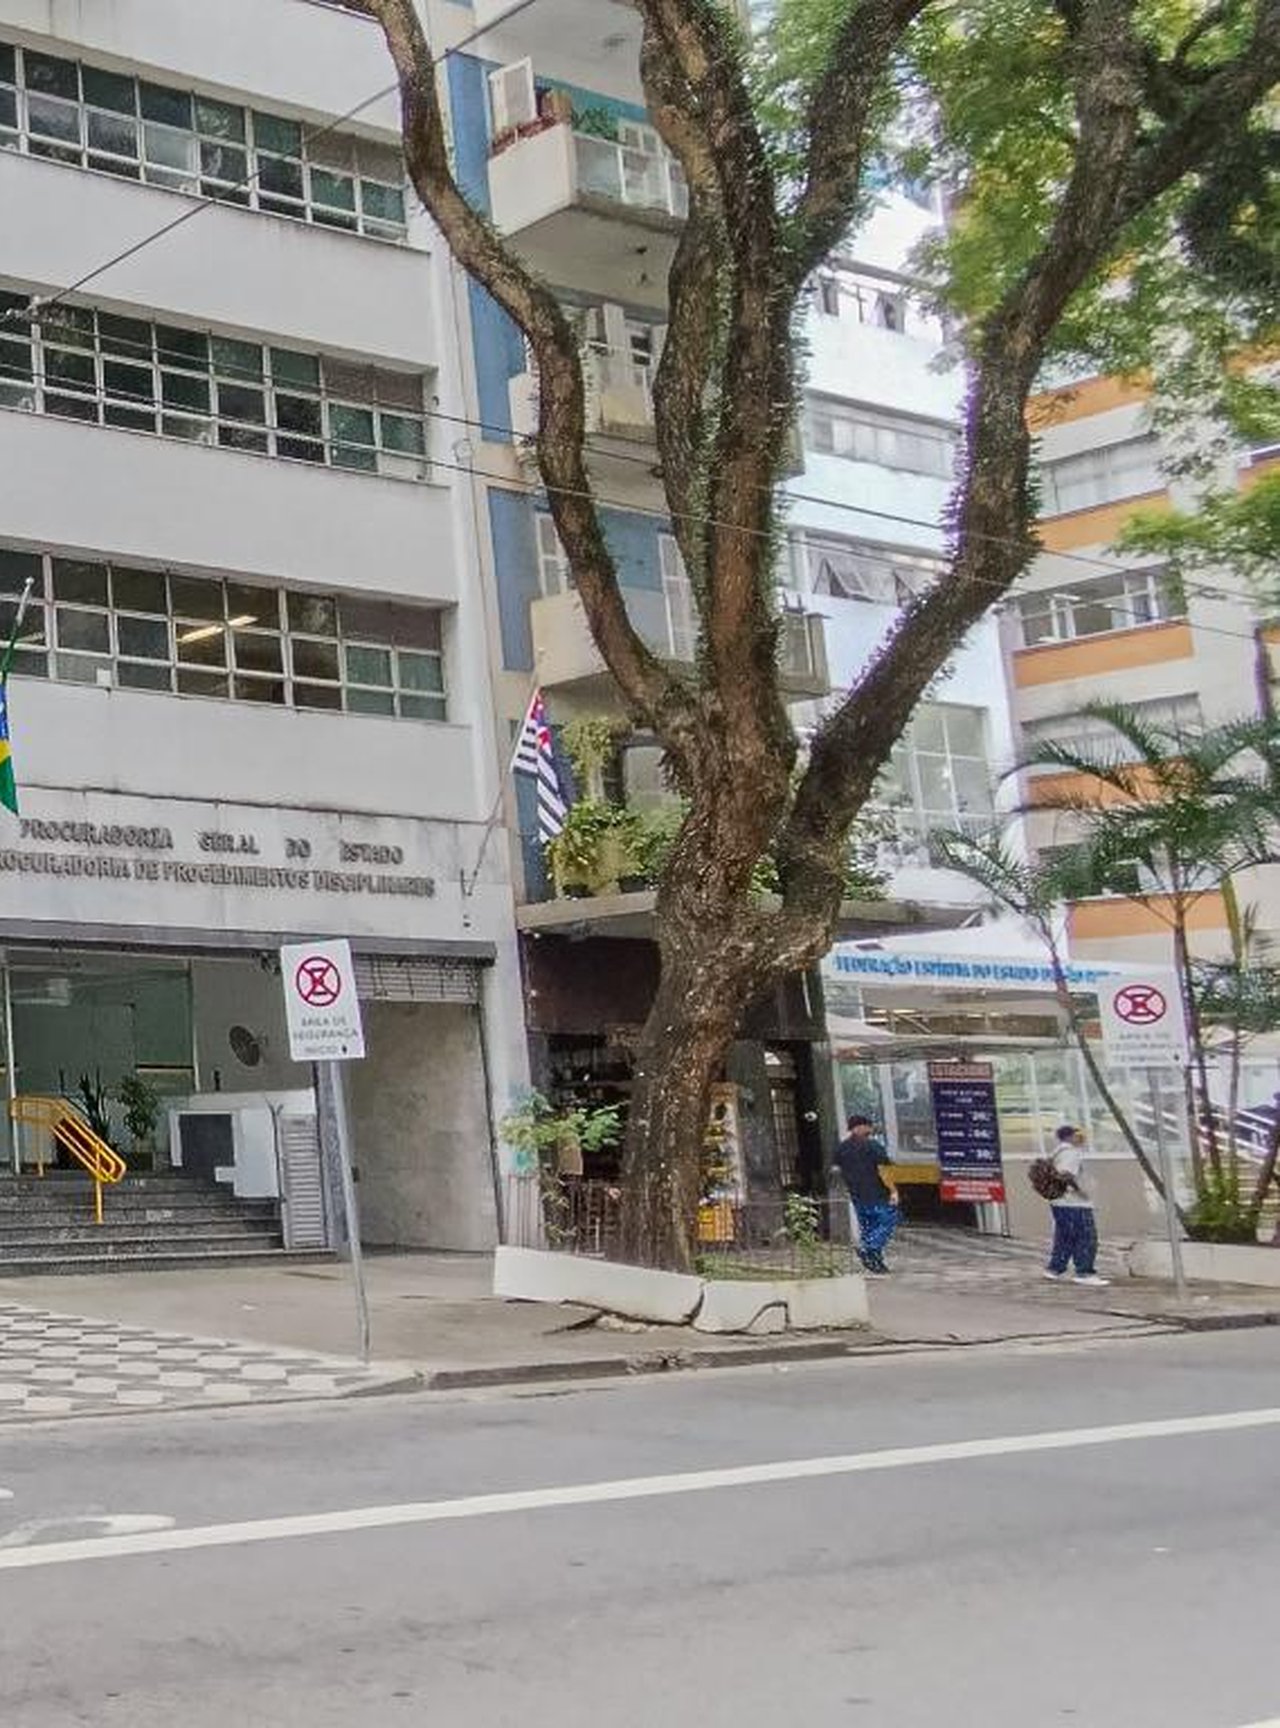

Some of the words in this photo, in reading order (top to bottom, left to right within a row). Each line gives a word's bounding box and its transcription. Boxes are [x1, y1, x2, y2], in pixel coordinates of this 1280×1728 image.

[19, 818, 174, 850] PROCURADORIA
[199, 831, 261, 855] GERAL
[285, 837, 312, 859] DO
[340, 840, 404, 865] ESTADO
[134, 859, 160, 881] DE
[163, 861, 309, 890] PROCEDIMENTOS
